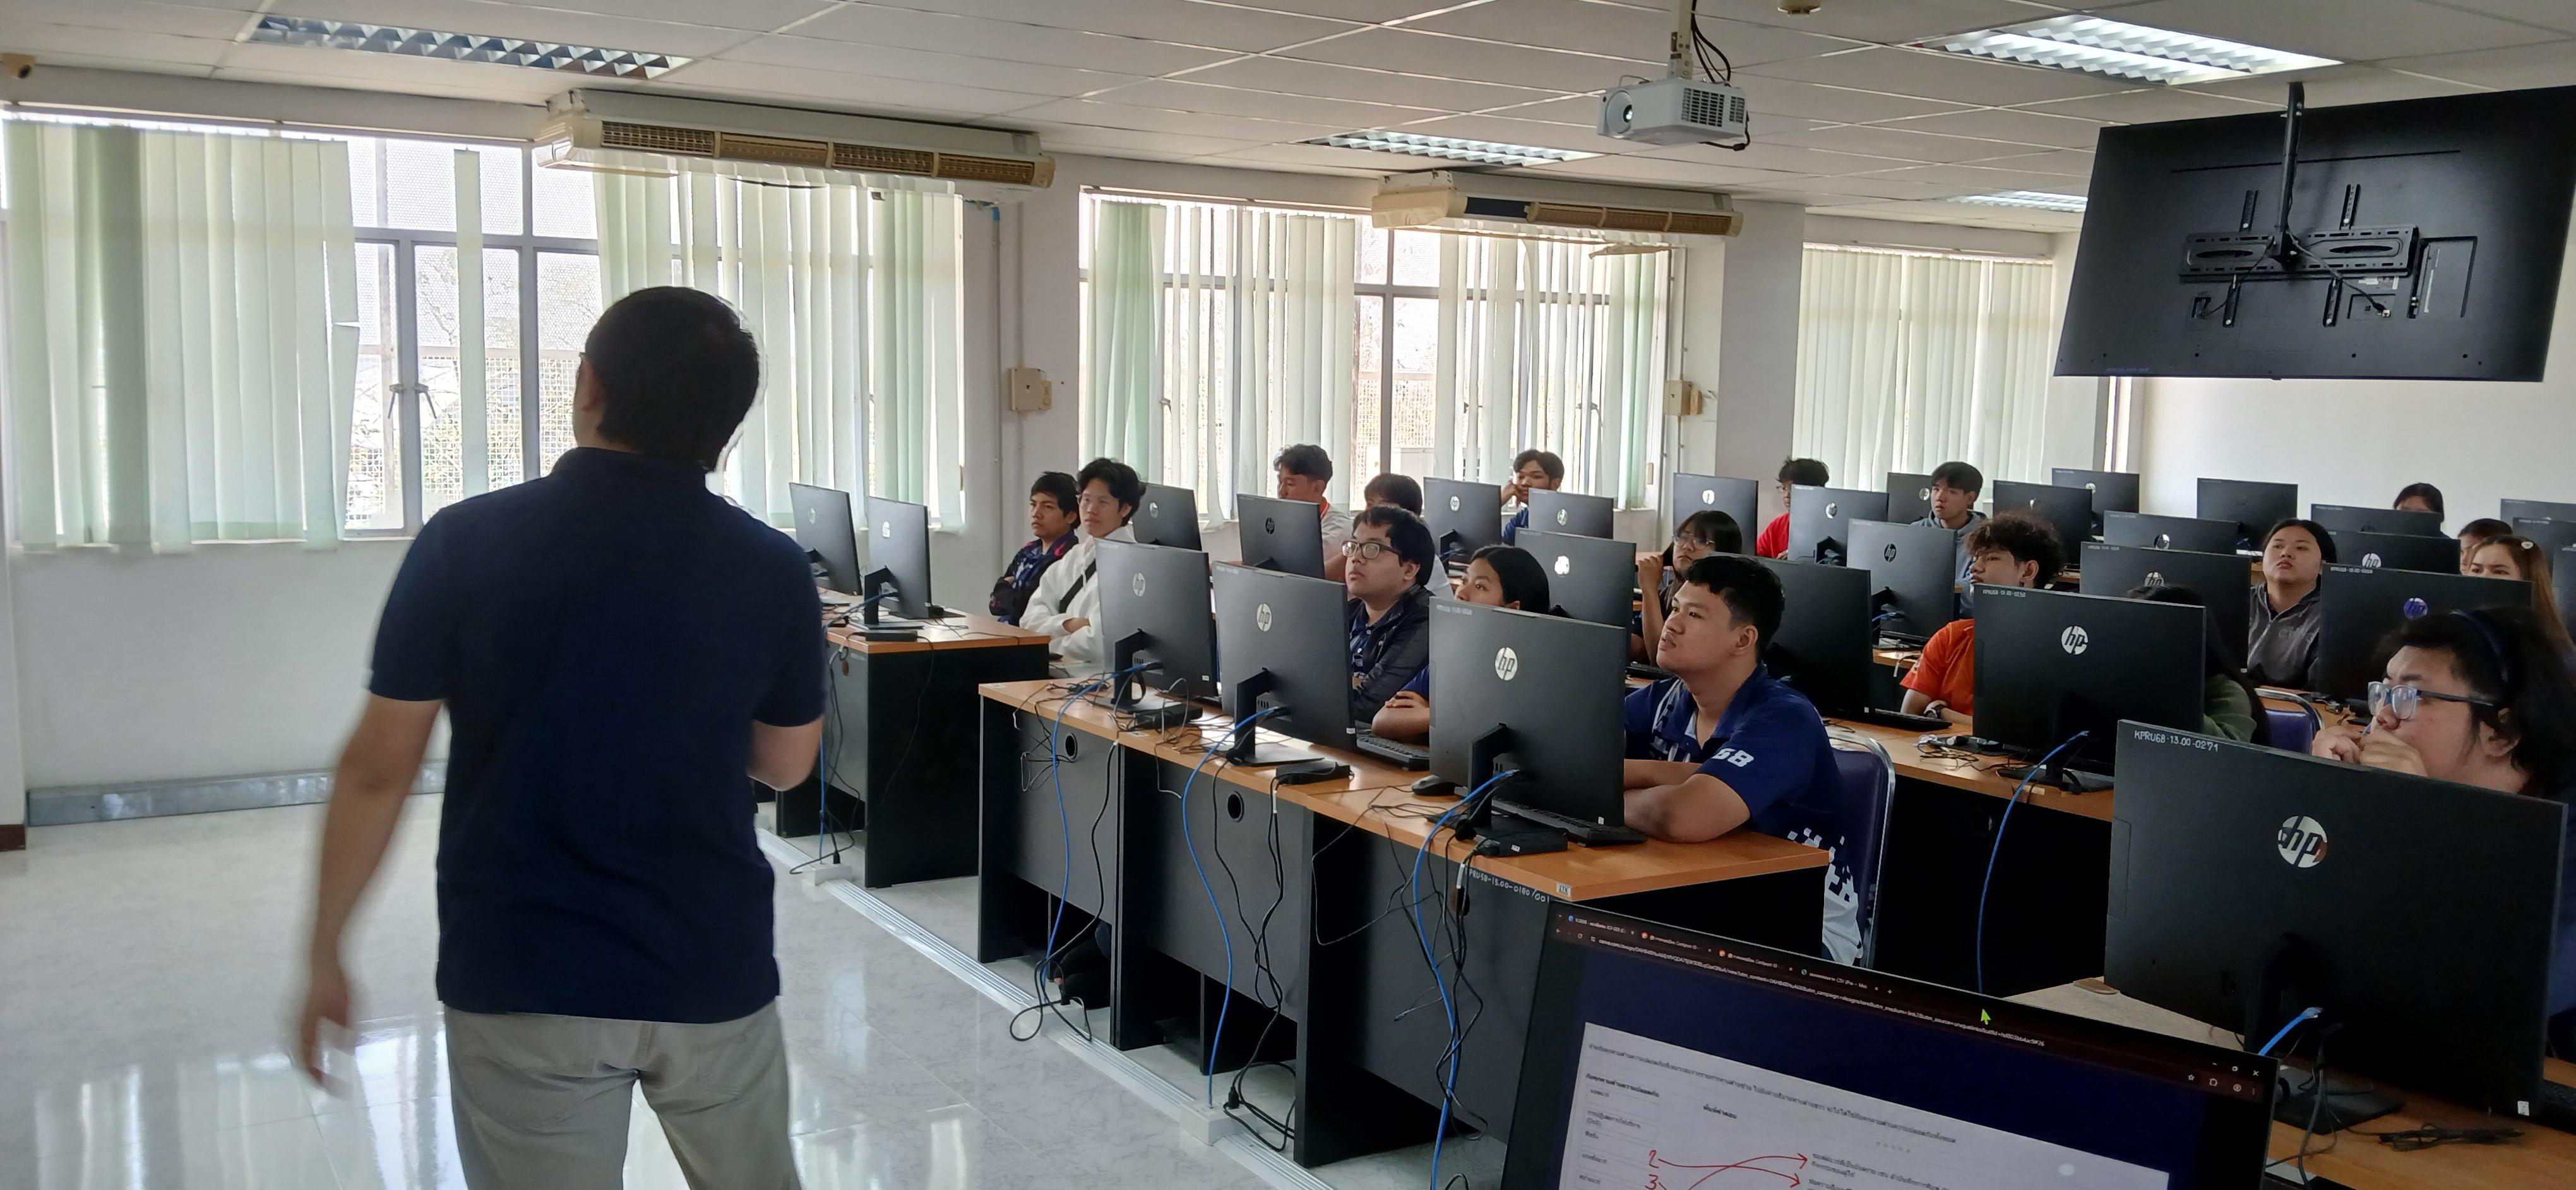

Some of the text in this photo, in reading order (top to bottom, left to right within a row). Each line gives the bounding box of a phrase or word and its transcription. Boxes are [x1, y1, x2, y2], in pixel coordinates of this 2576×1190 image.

[1884, 543, 1897, 563] hp
[1256, 603, 1273, 632] hp
[2061, 625, 2089, 655] hp
[1494, 647, 1518, 681] hp
[2277, 815, 2329, 868] hp
[1649, 1149, 1659, 1169] 2
[1645, 1174, 1659, 1190] 3
